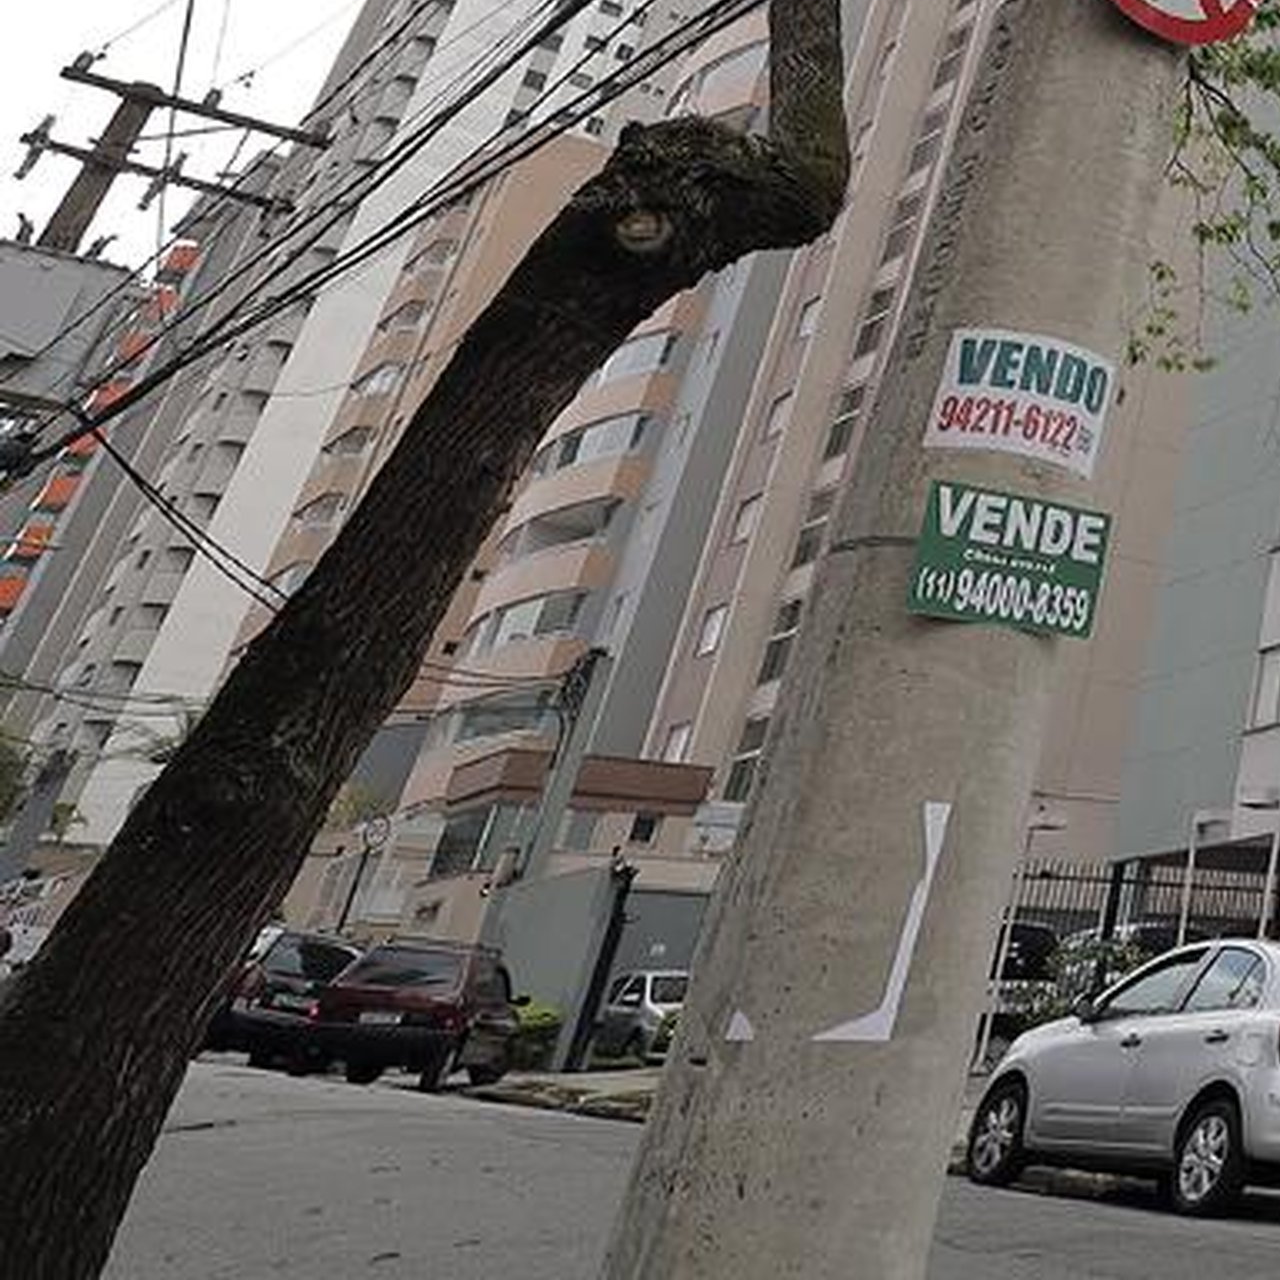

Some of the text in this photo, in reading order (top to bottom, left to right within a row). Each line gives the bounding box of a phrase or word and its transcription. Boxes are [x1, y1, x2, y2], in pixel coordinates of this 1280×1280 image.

[958, 338, 1108, 414] VENDO
[938, 395, 1078, 451] 94211-6122
[939, 485, 1106, 564] VENDE
